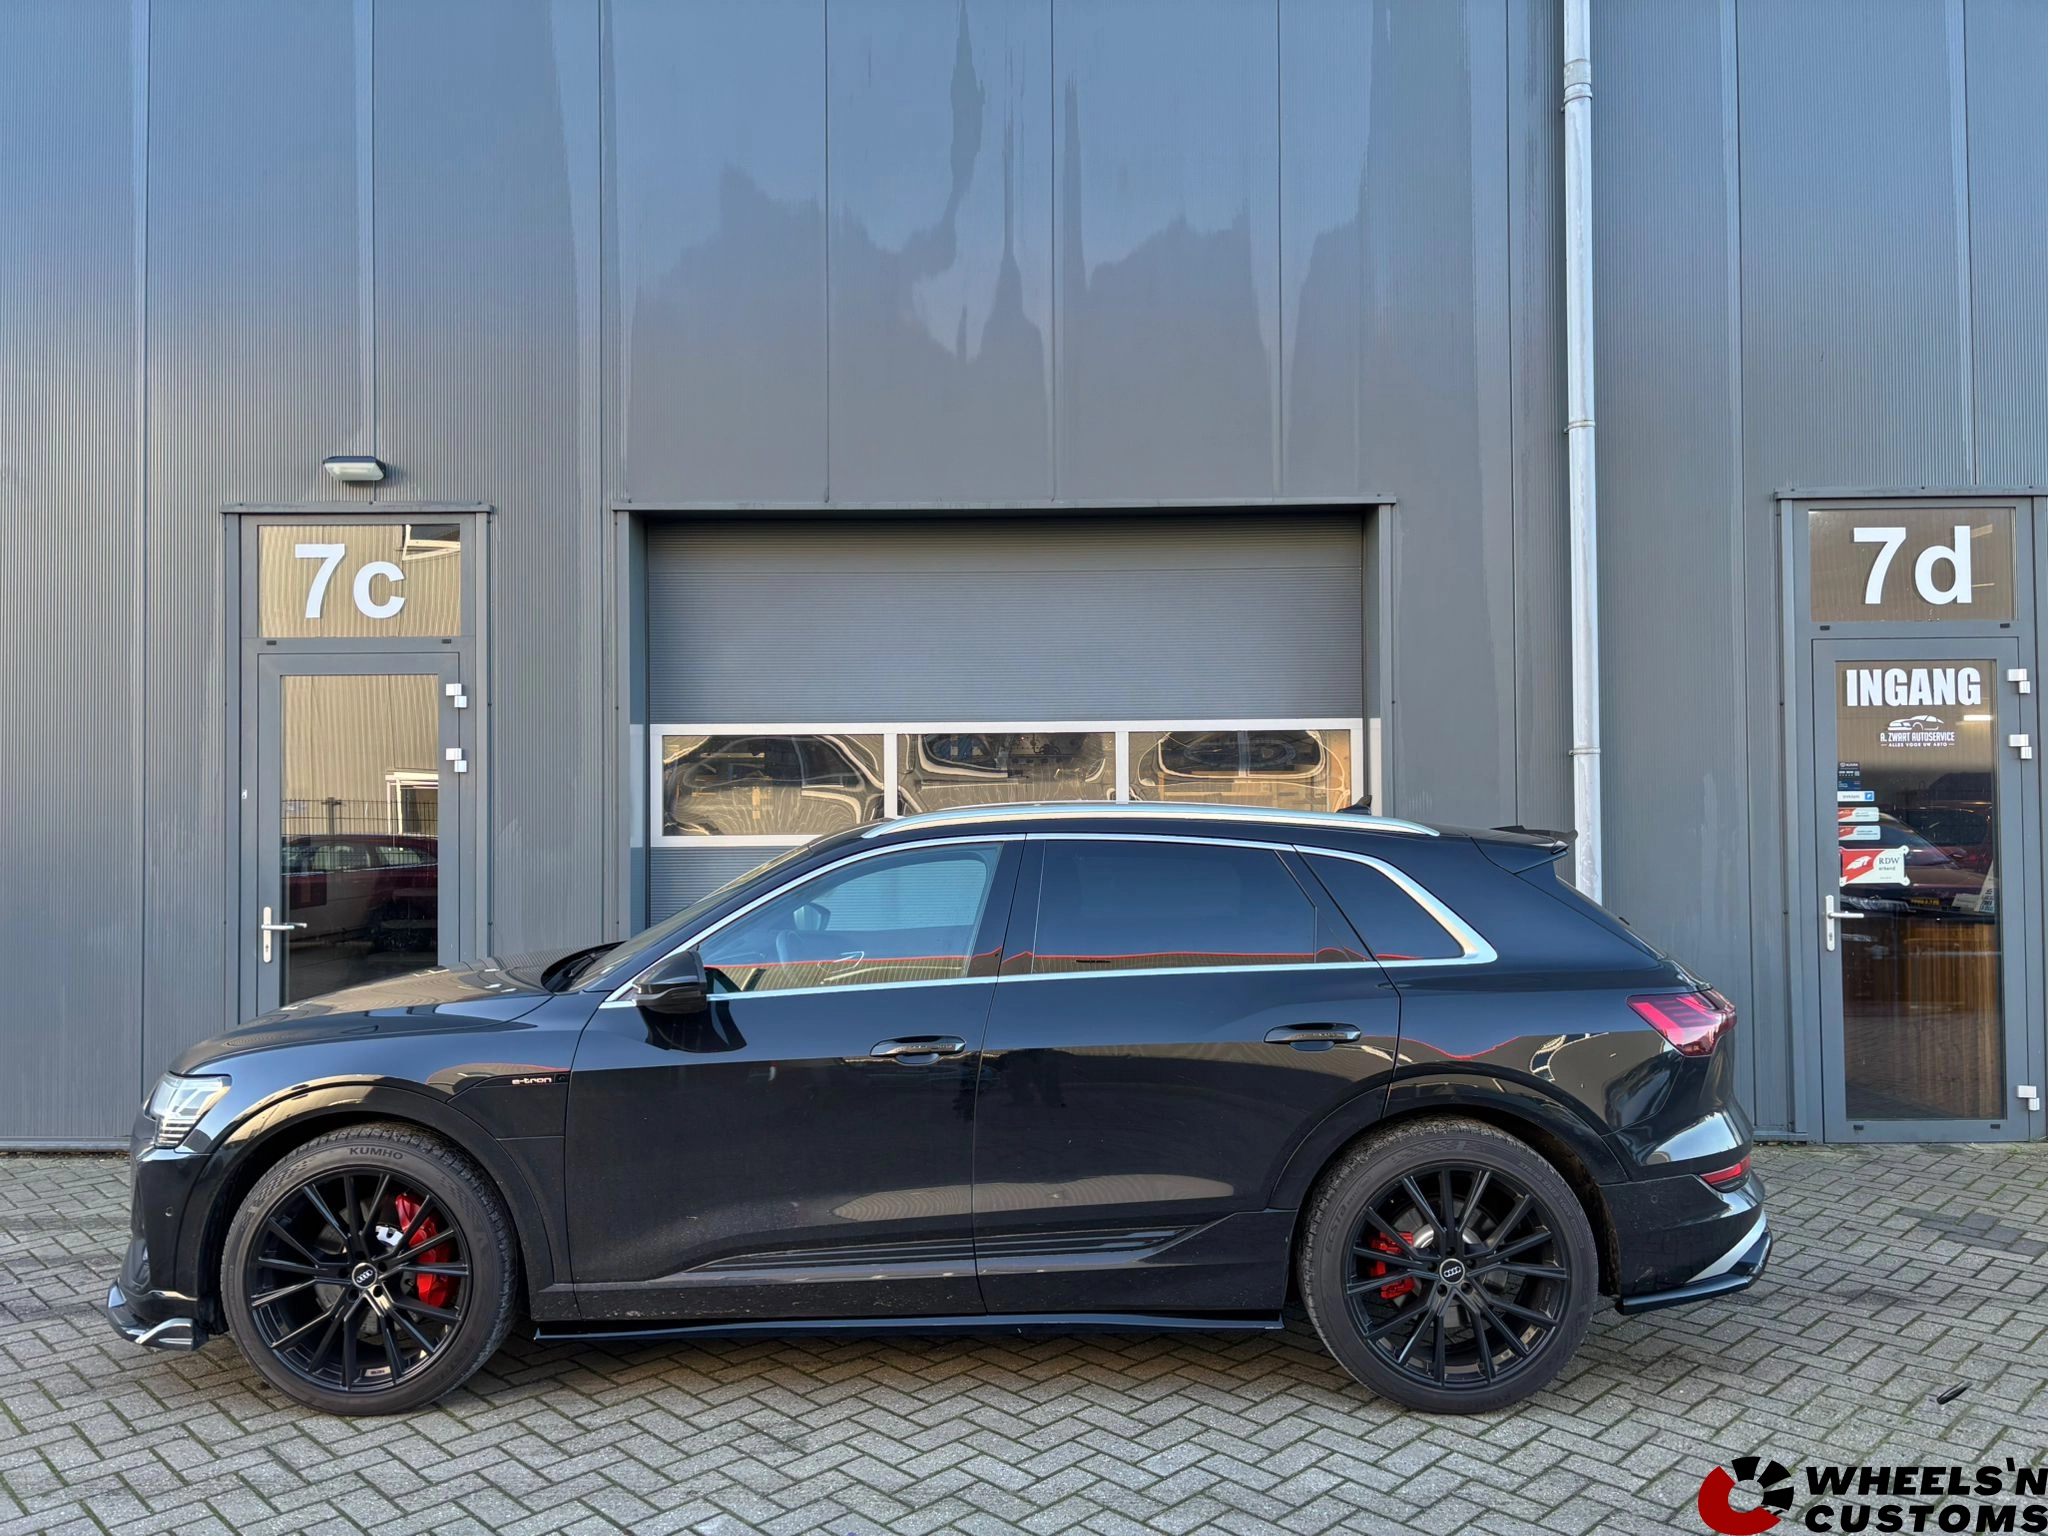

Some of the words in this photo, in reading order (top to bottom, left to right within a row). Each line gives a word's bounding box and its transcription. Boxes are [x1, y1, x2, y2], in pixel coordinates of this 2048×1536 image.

[1853, 525, 1972, 605] 7d
[294, 543, 406, 619] 7c
[1846, 667, 1981, 707] INGANG
[1888, 732, 1911, 741] ZWART
[1911, 731, 1955, 741] AUTOSERVICE
[1878, 857, 1900, 865] RDW
[511, 1077, 552, 1085] e-tron
[349, 1147, 404, 1160] KUMHO
